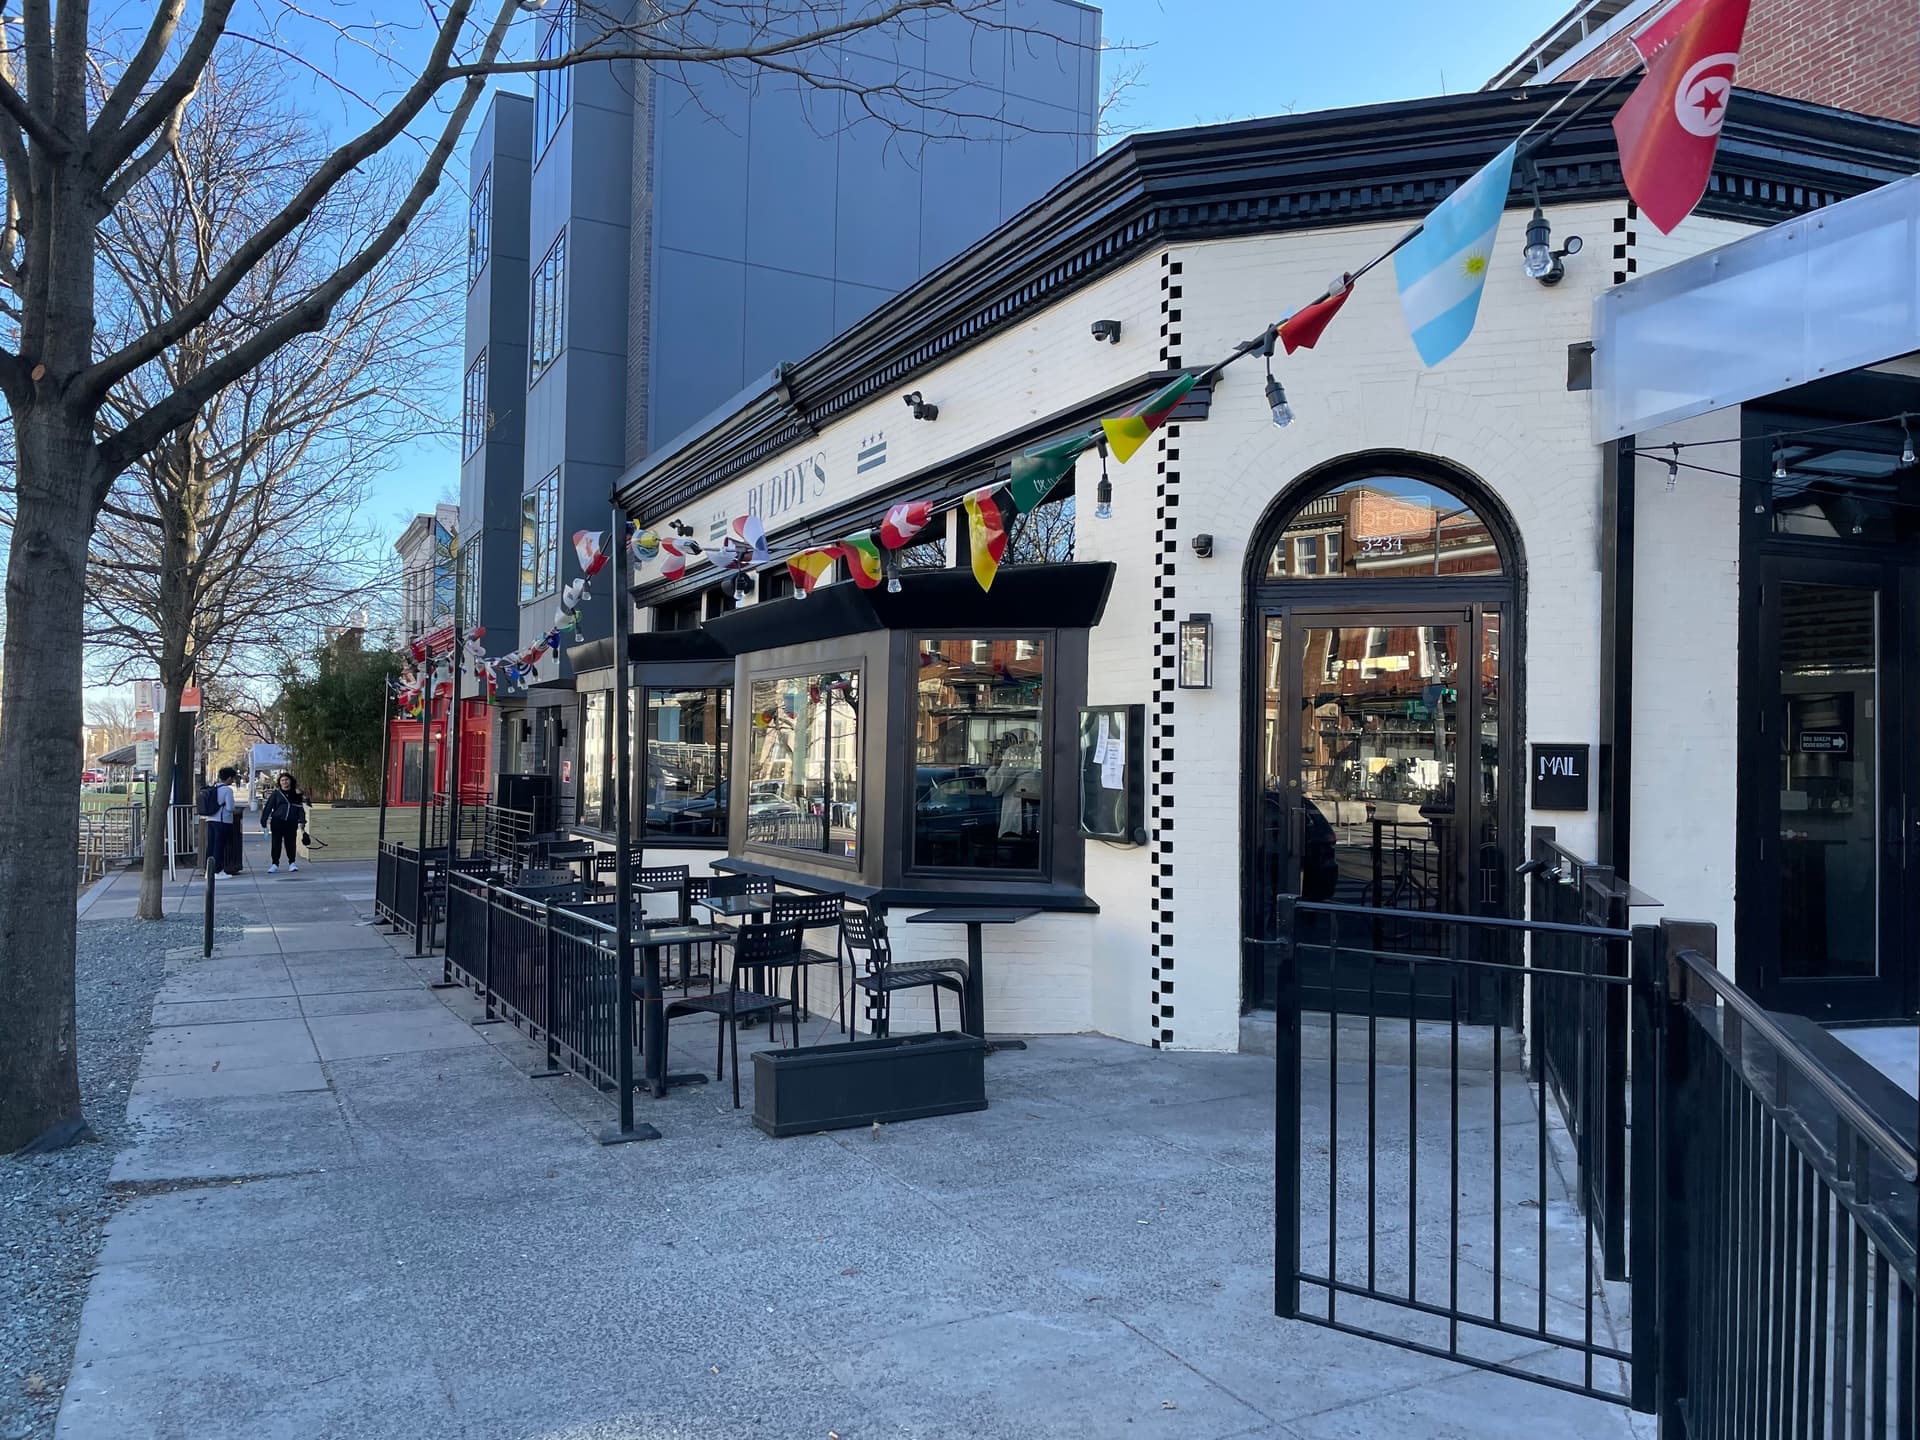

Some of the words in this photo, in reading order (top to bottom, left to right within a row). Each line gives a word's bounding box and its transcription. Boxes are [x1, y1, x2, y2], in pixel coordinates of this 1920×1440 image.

[748, 451, 827, 521] BUDDY'S
[1362, 509, 1422, 527] OPEN
[1362, 536, 1402, 551] 3234
[1540, 756, 1580, 776] MAIL
